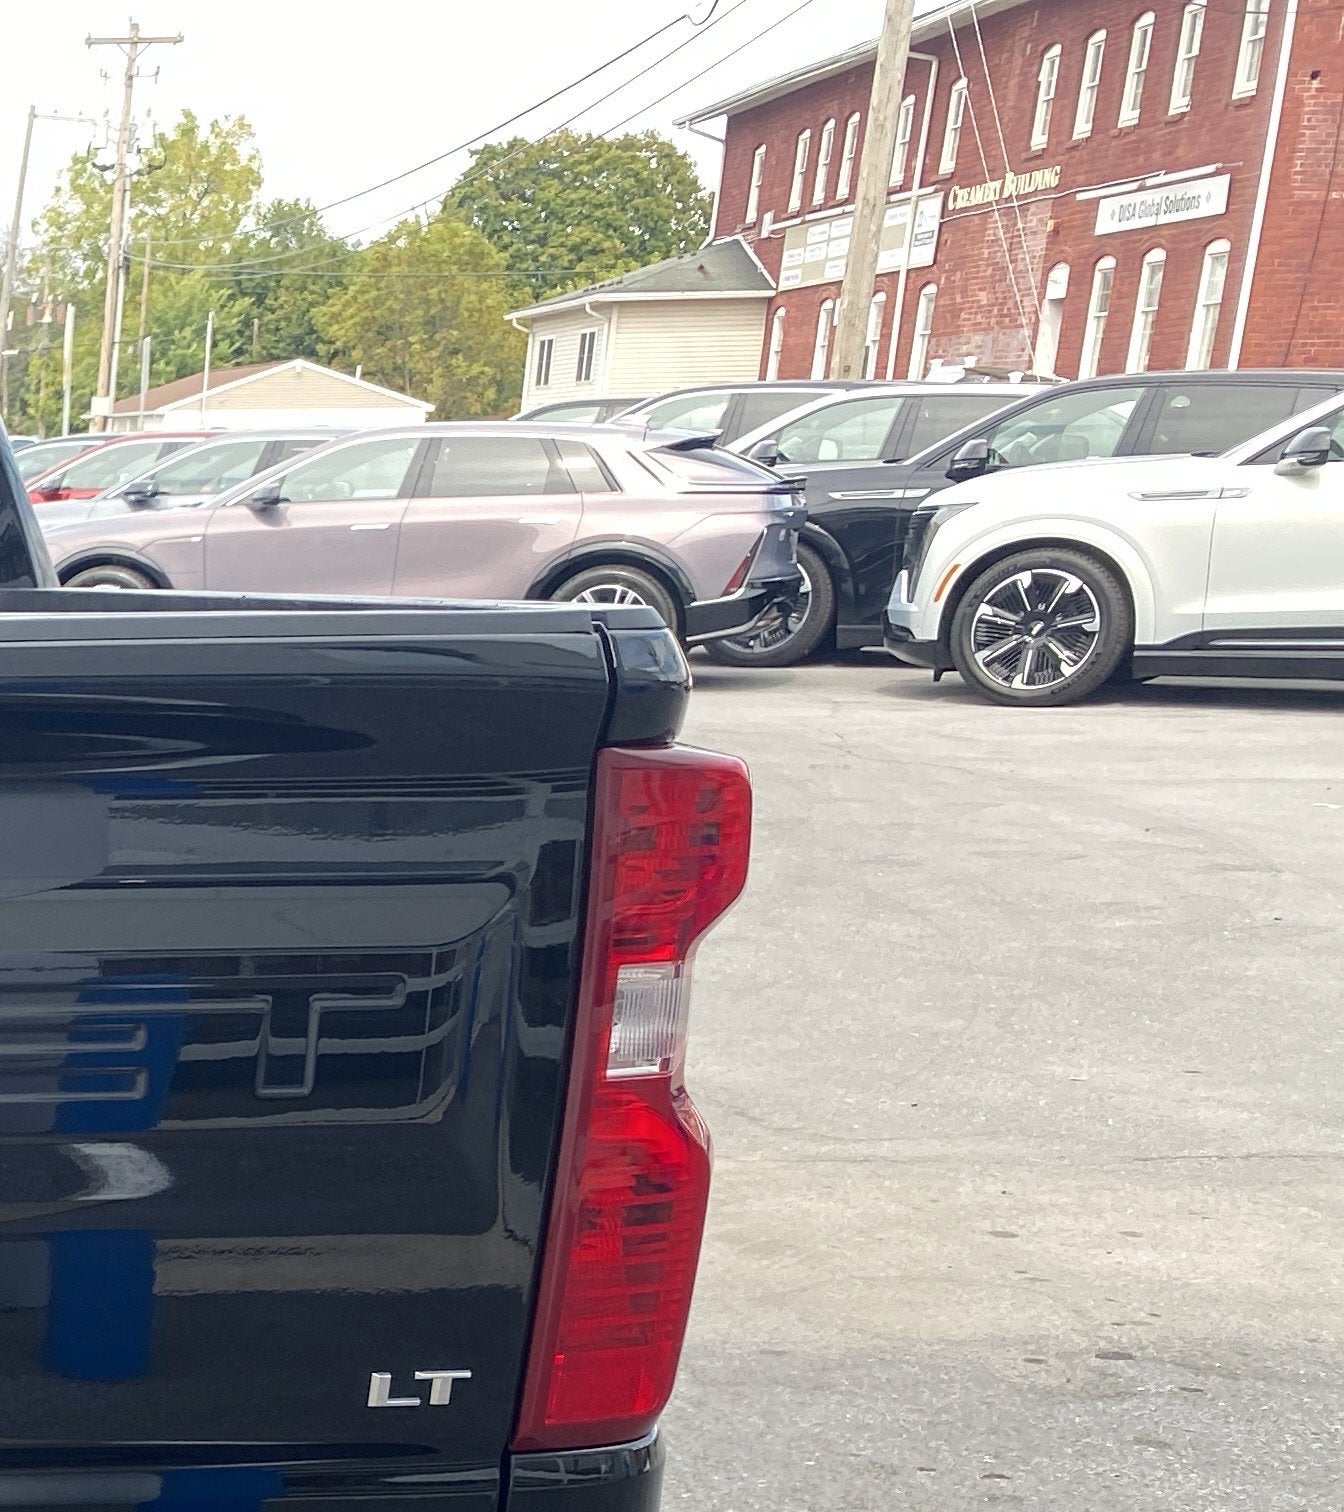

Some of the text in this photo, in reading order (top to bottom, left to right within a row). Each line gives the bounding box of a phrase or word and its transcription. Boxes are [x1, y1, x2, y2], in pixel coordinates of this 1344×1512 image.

[1118, 191, 1202, 223] DISA Global Solutions
[367, 1369, 472, 1407] LT
